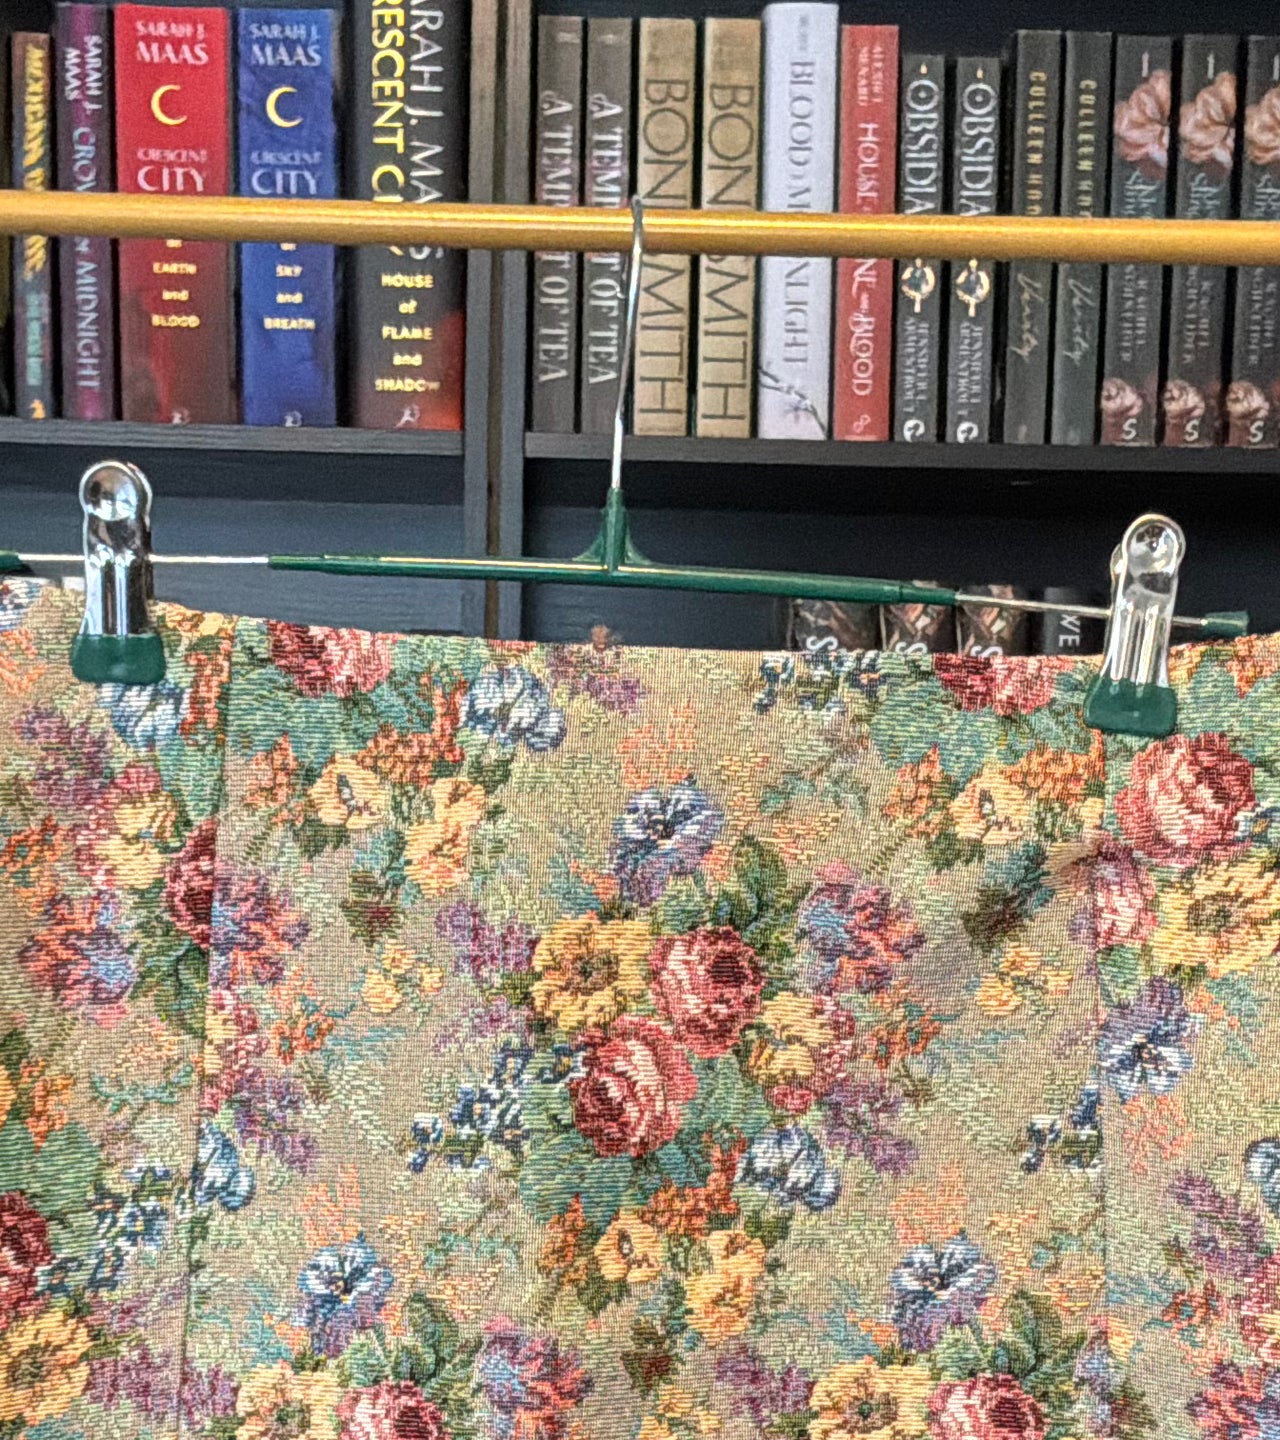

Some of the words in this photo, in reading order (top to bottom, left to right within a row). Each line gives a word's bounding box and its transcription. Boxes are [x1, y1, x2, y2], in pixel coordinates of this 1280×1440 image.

[136, 20, 192, 38] SARAH
[250, 23, 306, 41] SARAH
[137, 42, 209, 64] MAAS
[251, 44, 321, 67] MAAS
[788, 60, 815, 166] BLOOD
[1027, 70, 1046, 157] COLLEEN
[1077, 79, 1096, 172] COLLEEN
[854, 122, 879, 202] HOUSE
[137, 167, 207, 193] CITY
[251, 169, 321, 196] CITY
[382, 275, 433, 288] HOUSE
[540, 274, 570, 316] OF
[589, 277, 621, 316] OF
[75, 261, 101, 390] MIDNIGHT
[151, 315, 200, 328] BLOOD
[383, 327, 432, 340] FLAME
[538, 323, 568, 383] TEA
[588, 326, 618, 386] TEA
[848, 313, 875, 397] BLOOD
[375, 378, 439, 392] SHADOW
